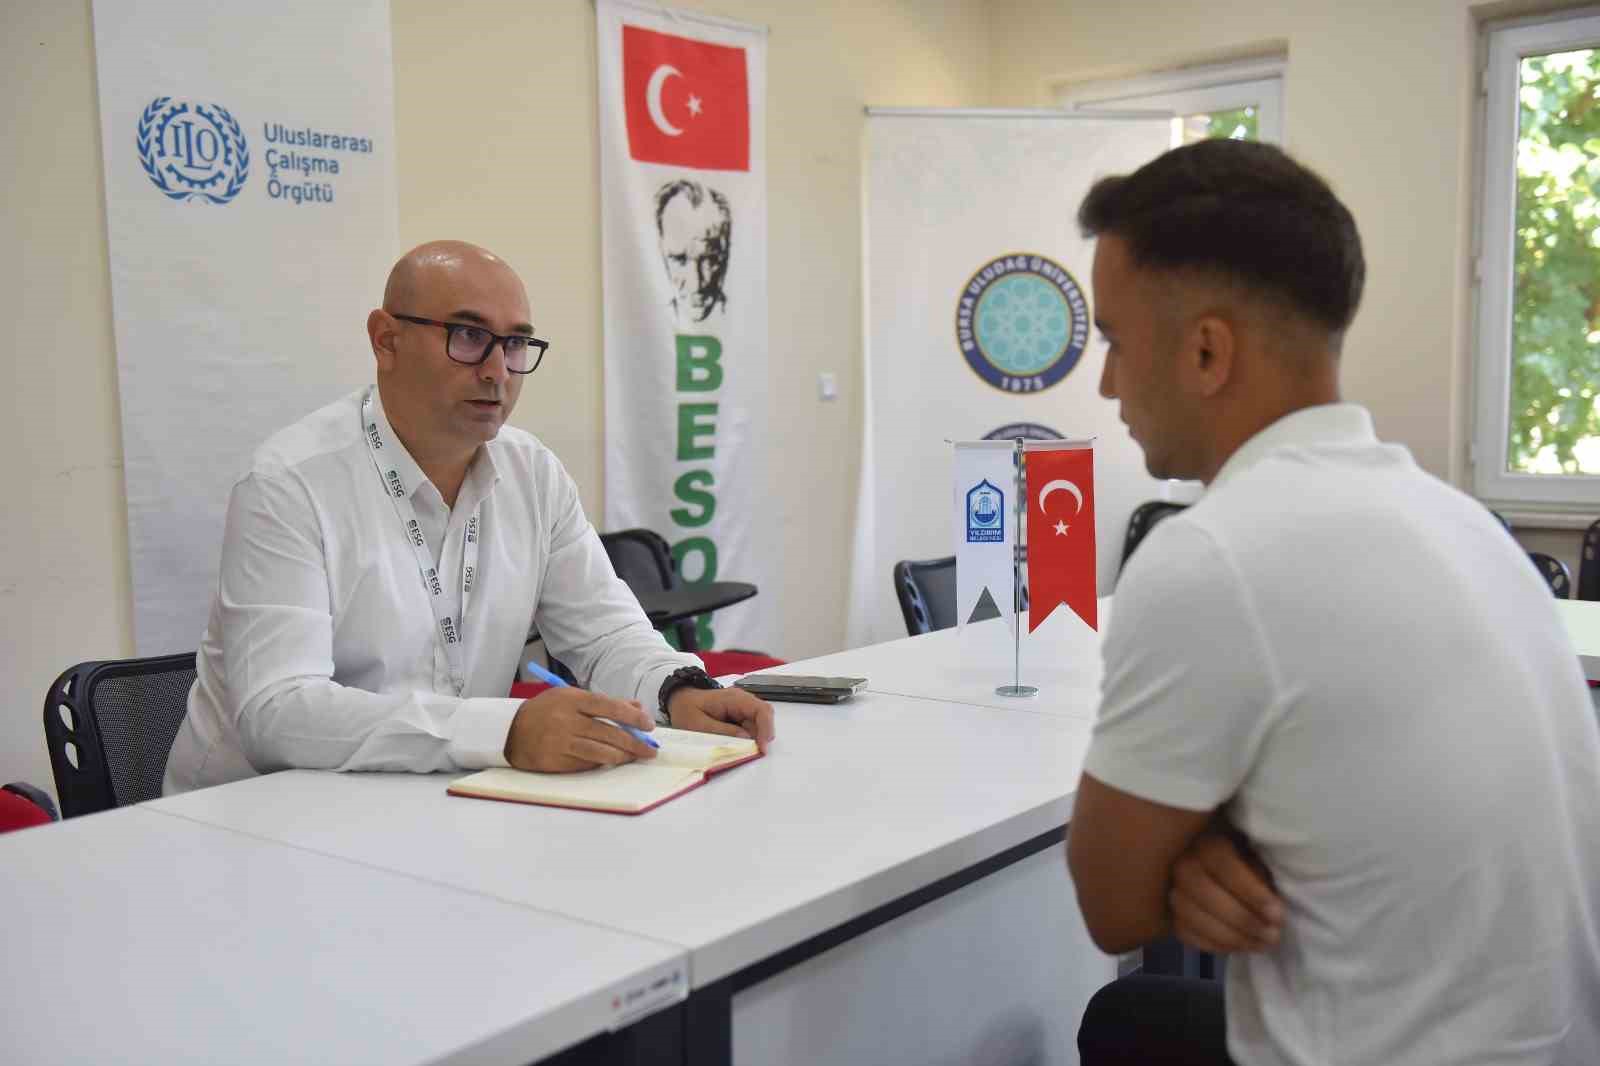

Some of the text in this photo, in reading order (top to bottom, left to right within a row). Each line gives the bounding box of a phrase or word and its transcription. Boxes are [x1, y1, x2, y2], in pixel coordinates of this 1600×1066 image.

[169, 120, 218, 170] ILO
[263, 122, 374, 153] Uluslararası
[264, 149, 340, 178] Çalışma
[267, 174, 334, 205] Örgütü
[958, 297, 975, 351] BURSA
